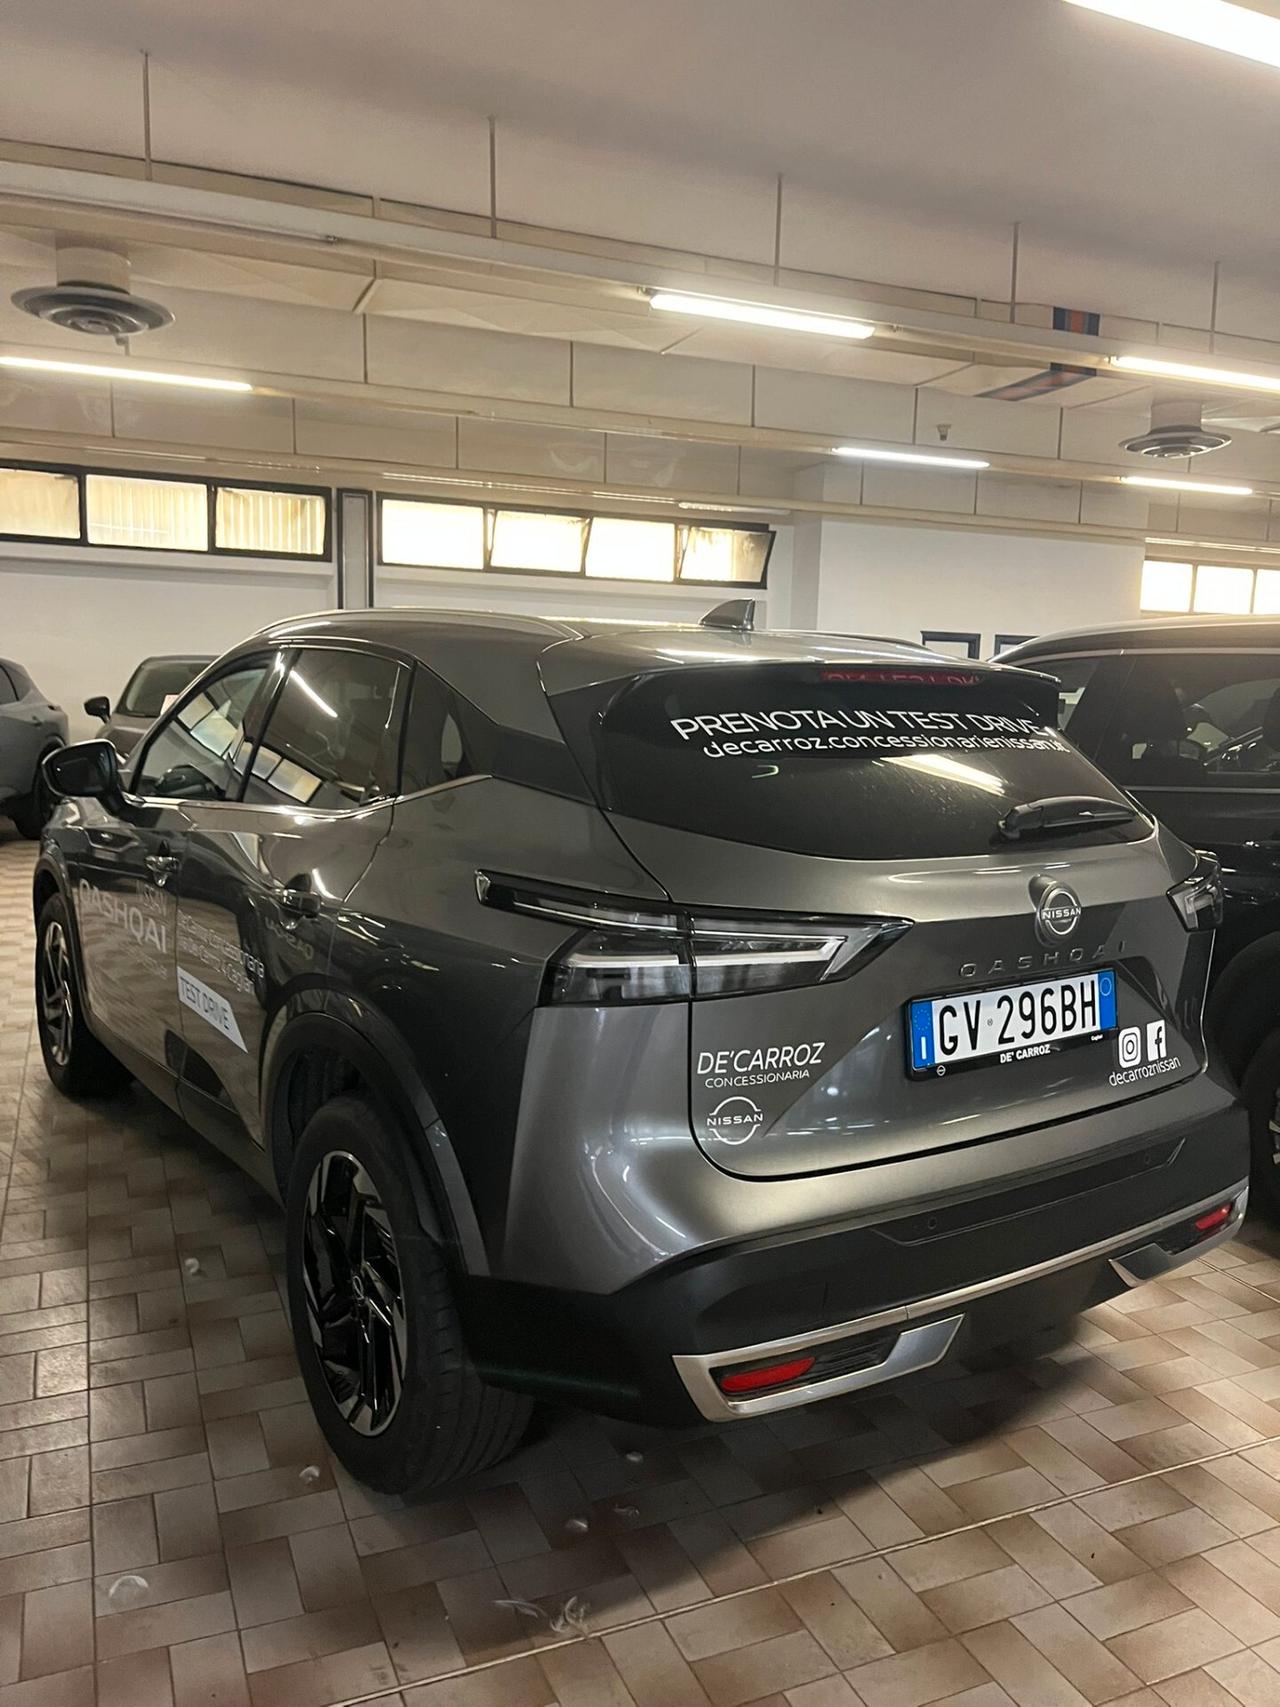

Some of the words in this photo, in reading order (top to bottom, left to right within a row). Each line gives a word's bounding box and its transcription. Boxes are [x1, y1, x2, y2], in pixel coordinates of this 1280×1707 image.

[671, 709, 839, 740] PRENOTA
[838, 709, 895, 729] UN
[896, 711, 967, 731] TEST
[79, 879, 167, 954] QASHQAI
[1041, 907, 1081, 921] NISSAN
[180, 976, 201, 1009] TEST
[203, 992, 229, 1030] DRIVE
[1016, 1044, 1051, 1060] CARROZ
[705, 1069, 809, 1088] CONCESSIONARIA
[1109, 1056, 1182, 1087] decarroznissan
[707, 1113, 763, 1126] NISSAN
